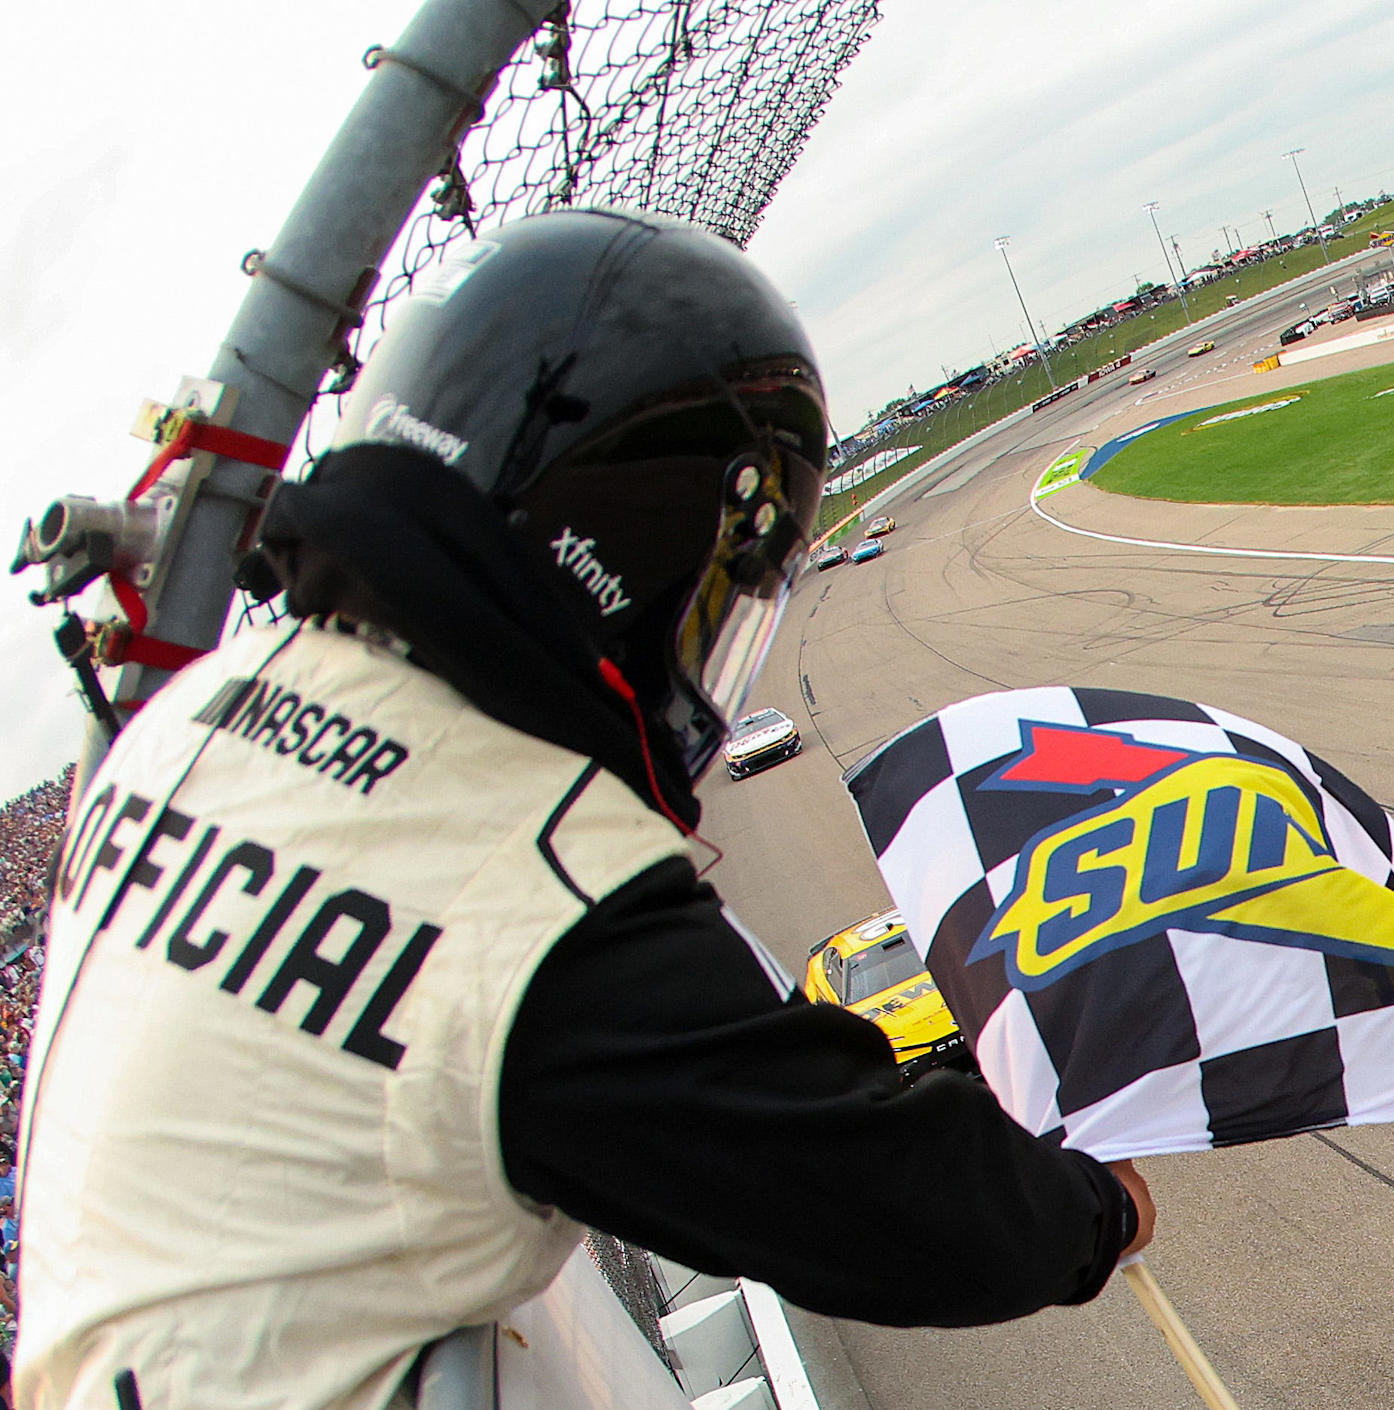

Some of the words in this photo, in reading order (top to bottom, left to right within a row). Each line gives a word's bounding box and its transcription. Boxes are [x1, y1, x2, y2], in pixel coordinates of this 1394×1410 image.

[550, 525, 632, 618] xfinity
[234, 680, 409, 797] NASCAR
[61, 790, 445, 1071] OFFICIAL
